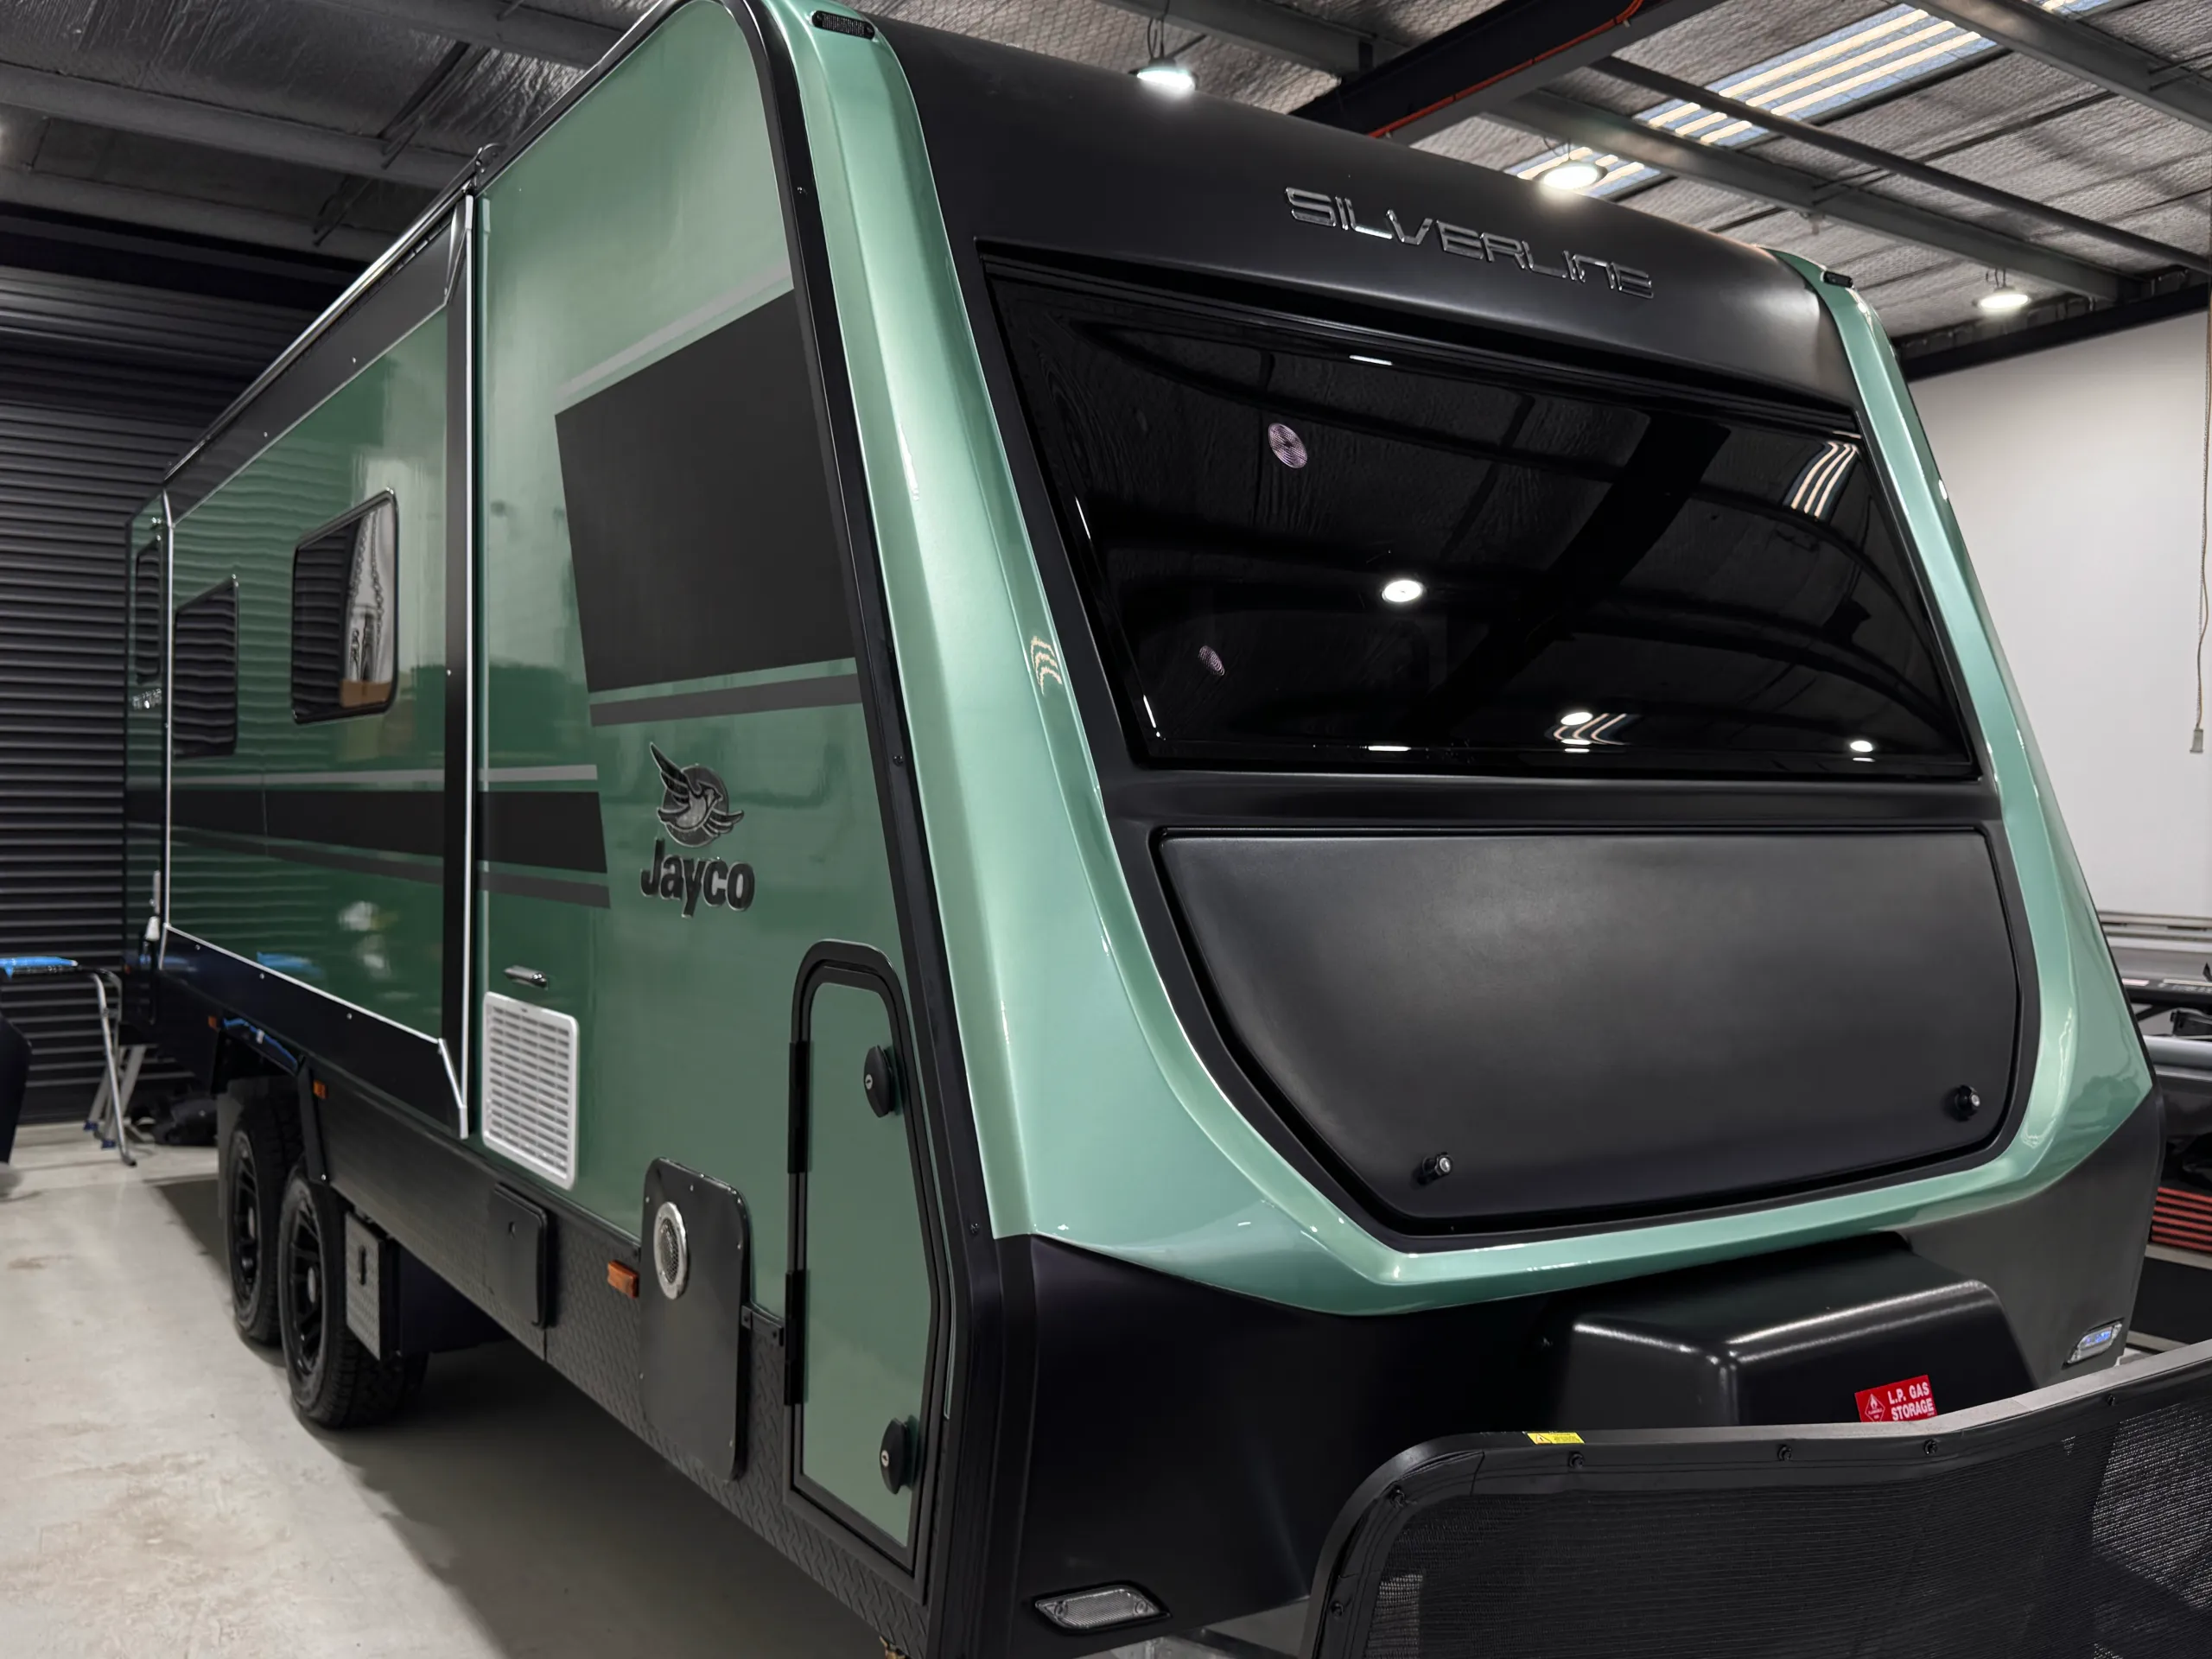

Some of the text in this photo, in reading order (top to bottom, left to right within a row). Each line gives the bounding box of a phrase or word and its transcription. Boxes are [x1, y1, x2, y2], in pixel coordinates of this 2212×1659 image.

[1284, 187, 1654, 299] SILVERLINE
[640, 836, 755, 918] Jayco
[1887, 1382, 1929, 1404] L.P. GAS
[1891, 1398, 1934, 1421] STORAGE
